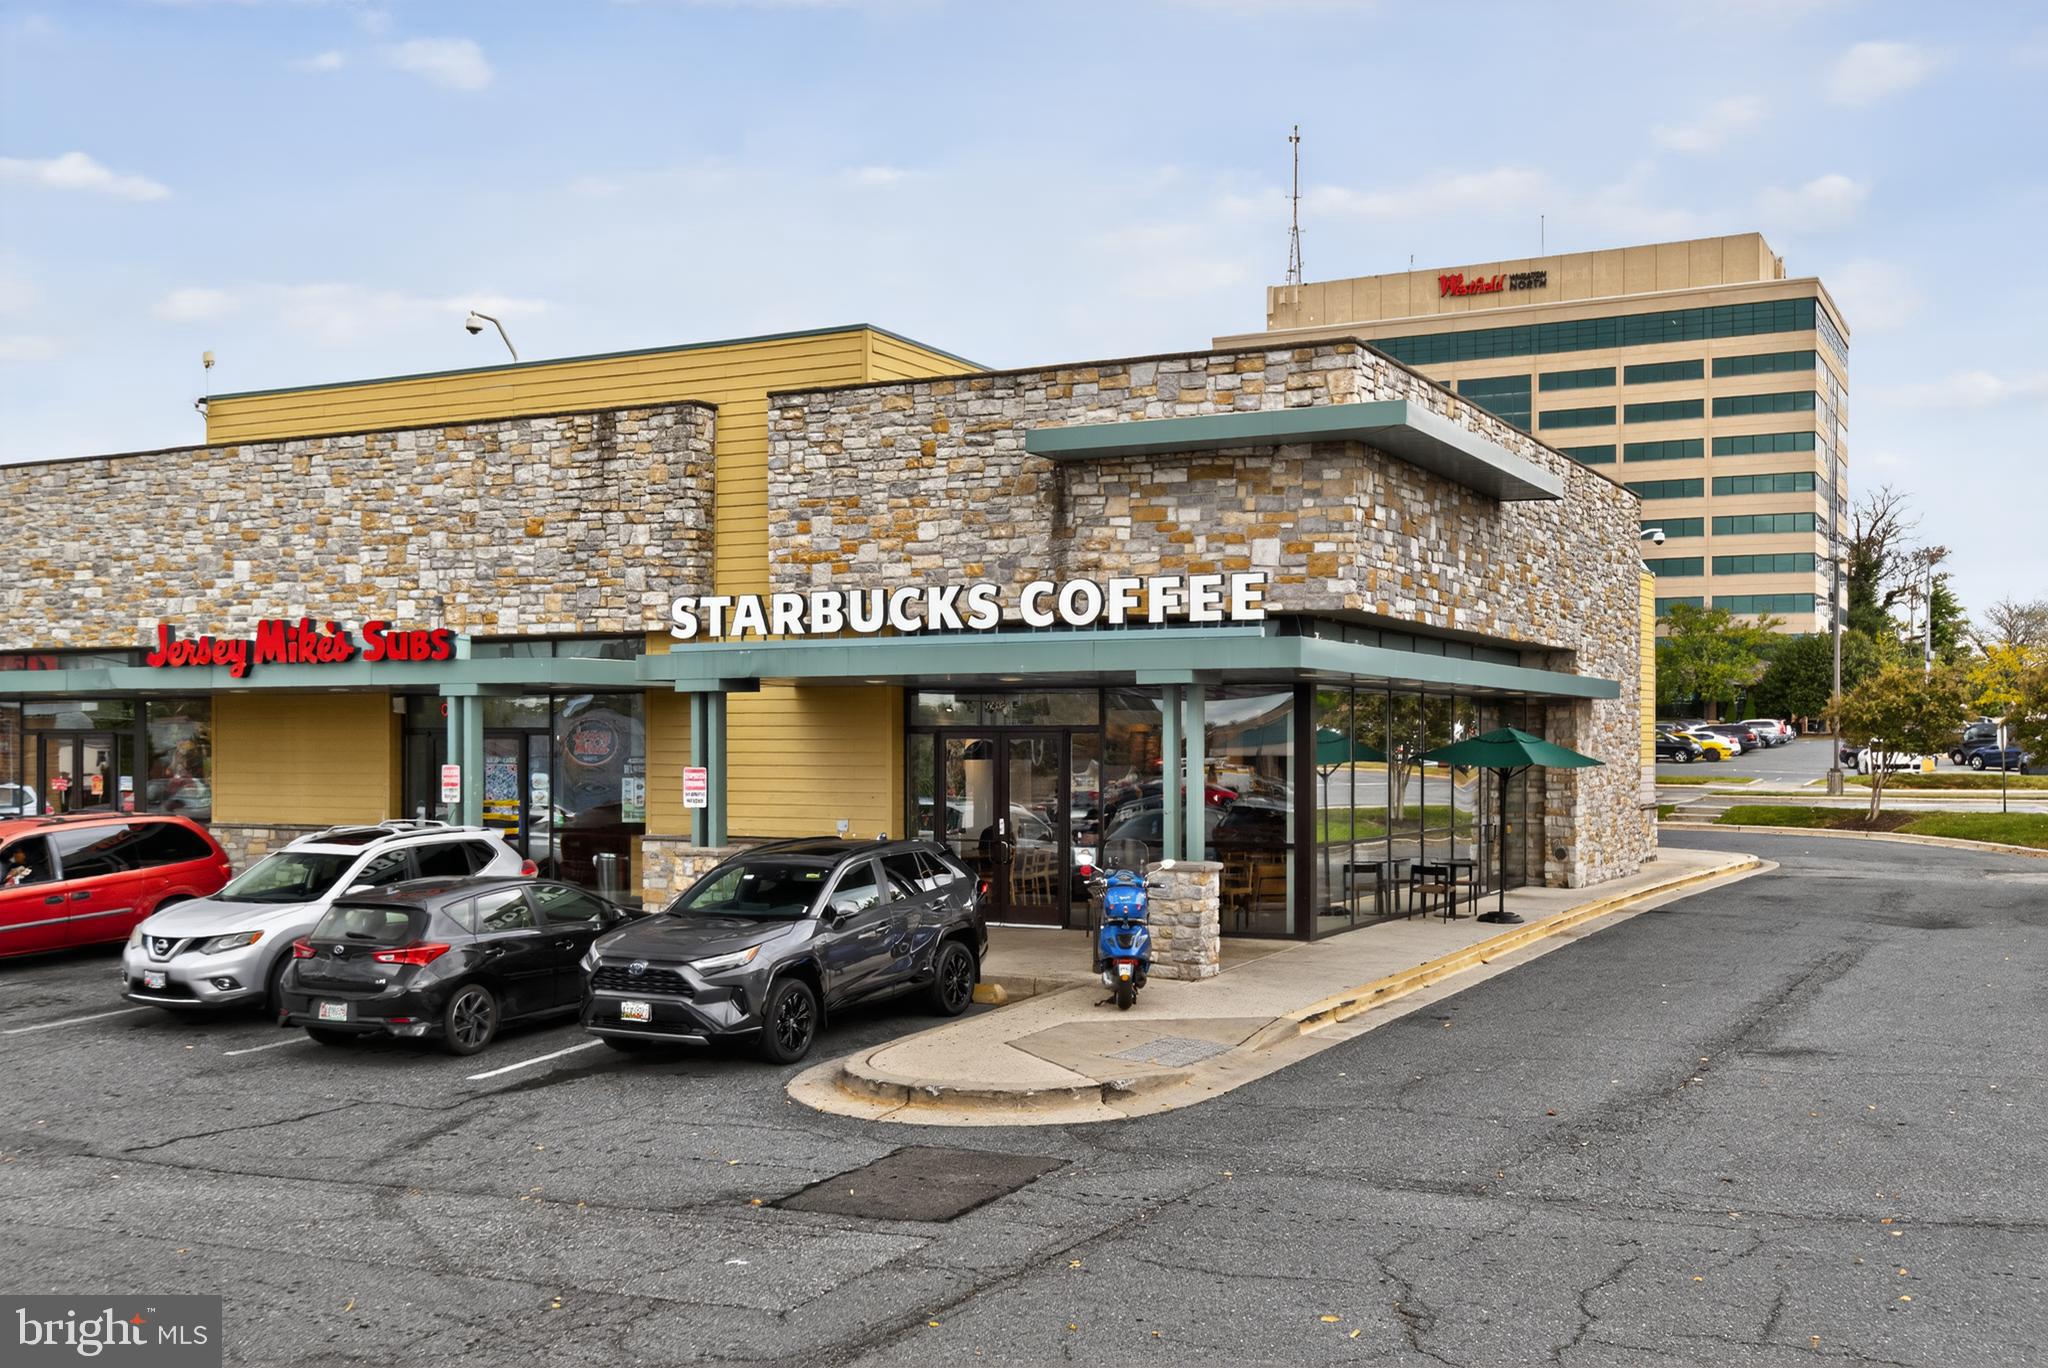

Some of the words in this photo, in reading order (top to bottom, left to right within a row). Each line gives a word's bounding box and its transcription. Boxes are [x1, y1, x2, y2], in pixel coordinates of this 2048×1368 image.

[1509, 279, 1547, 291] NORTH
[669, 583, 1002, 640] STARBUCKS
[1018, 571, 1267, 628] COFFEE
[146, 623, 252, 679] Jersey
[253, 617, 357, 665] Mike's
